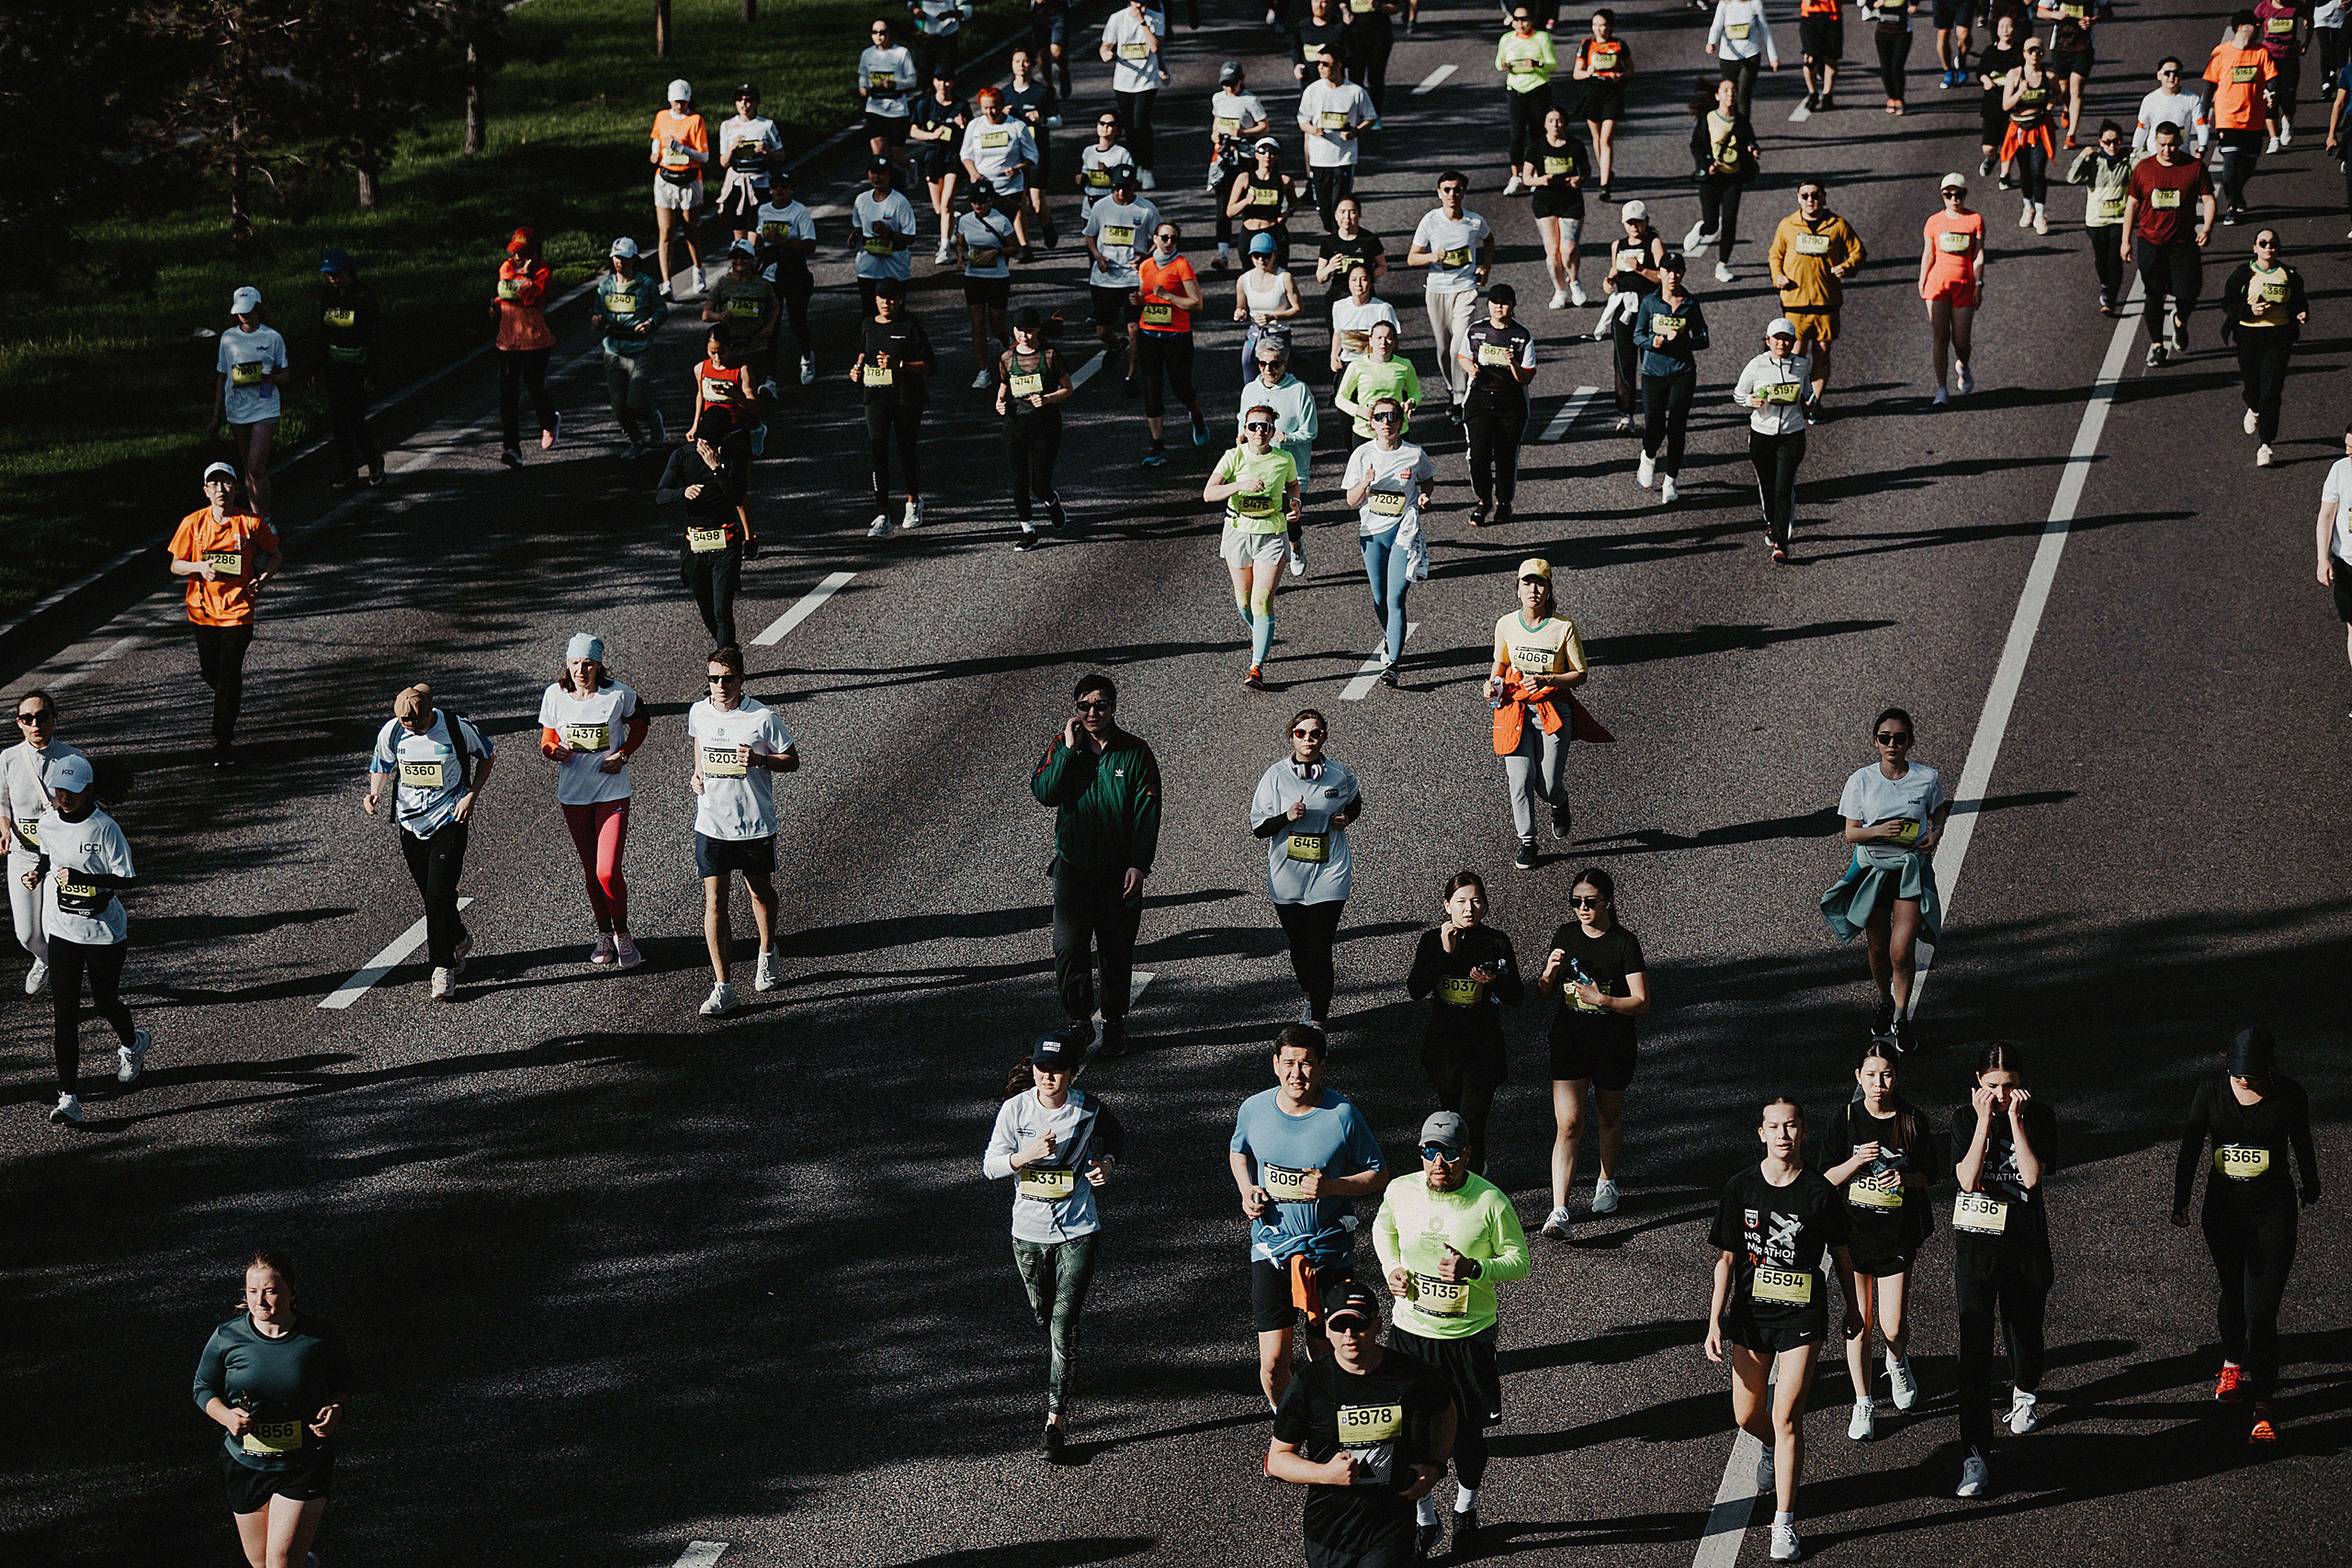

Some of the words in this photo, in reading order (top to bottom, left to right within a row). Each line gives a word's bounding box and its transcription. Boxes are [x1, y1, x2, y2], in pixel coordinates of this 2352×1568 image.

[1146, 306, 1167, 315] 4349
[1484, 346, 1502, 355] 667
[1014, 375, 1035, 386] 4747
[1773, 385, 1794, 395] 5197
[1374, 494, 1399, 504] 7202
[1242, 500, 1269, 511] 5475
[694, 531, 719, 542] 5498
[1518, 650, 1548, 663] 4068
[572, 728, 604, 739] 4378
[708, 752, 739, 763] 6203
[404, 765, 435, 775] 6360
[1294, 837, 1325, 850] 6456
[1443, 979, 1476, 992] 6037
[2222, 1149, 2261, 1163] 6365
[1029, 1170, 1063, 1185] 5331
[1962, 1199, 1998, 1214] 5596
[1762, 1271, 1804, 1288] 5594
[1421, 1281, 1459, 1299] 5135
[1348, 1408, 1393, 1427] 5978
